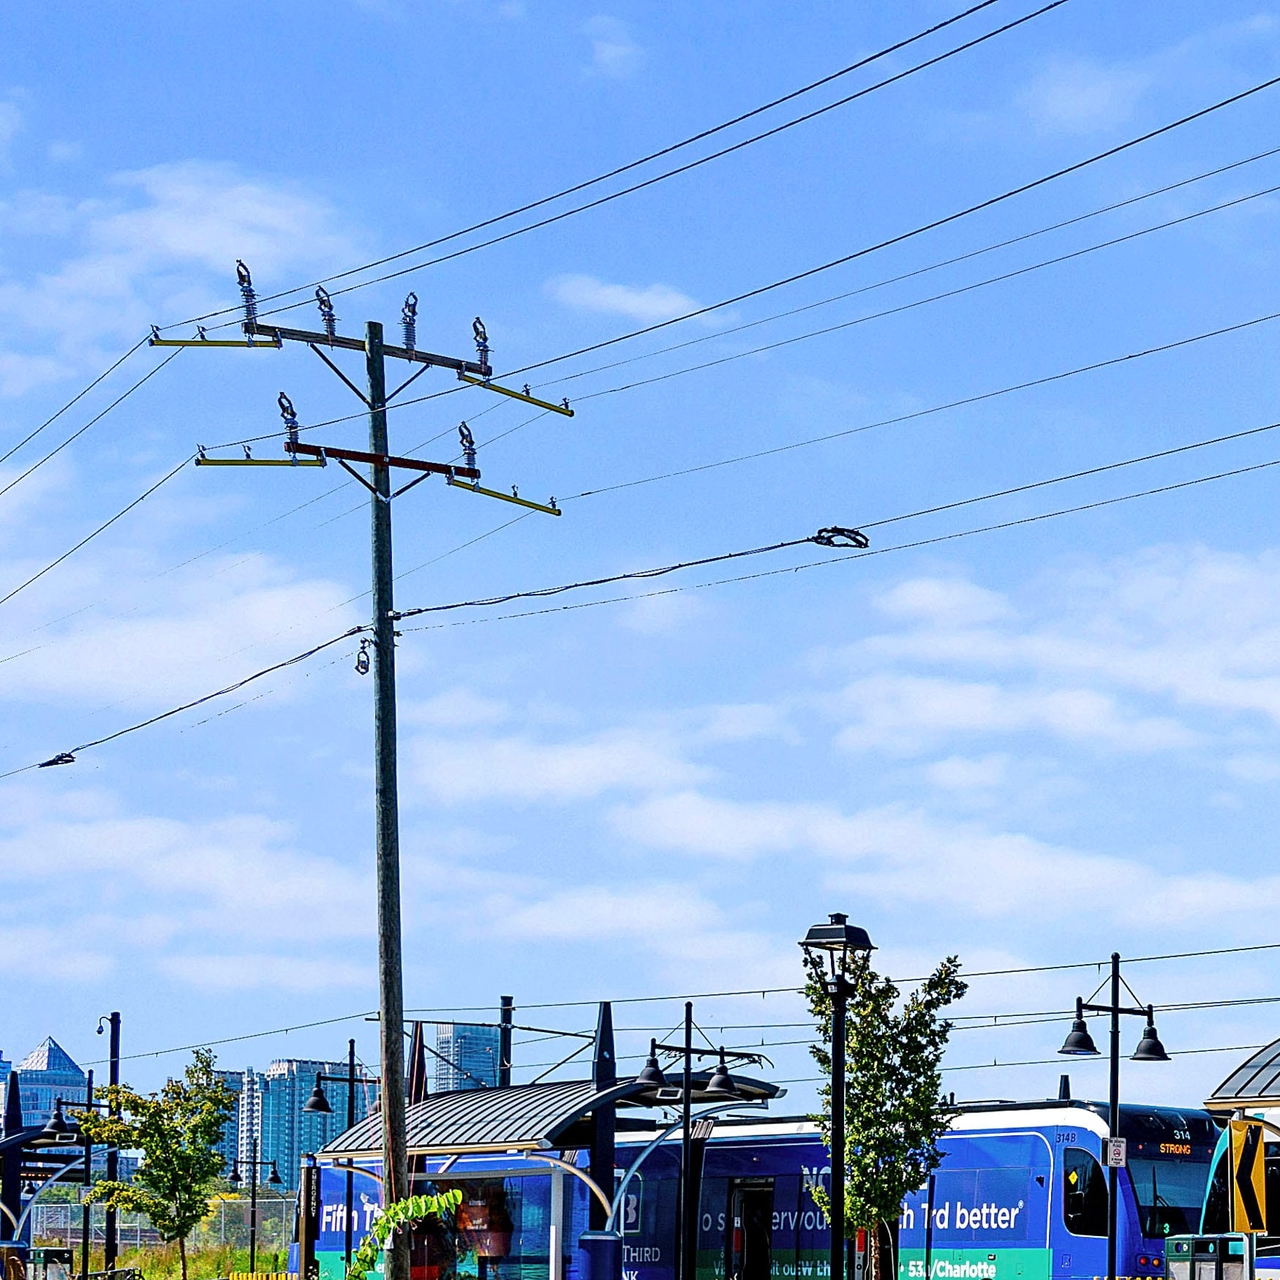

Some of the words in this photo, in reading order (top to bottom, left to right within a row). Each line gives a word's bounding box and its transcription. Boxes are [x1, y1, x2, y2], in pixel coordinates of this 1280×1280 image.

[1173, 1130, 1190, 1140] 314
[1159, 1143, 1191, 1155] STRONG
[1162, 1223, 1170, 1234] 3
[622, 1244, 661, 1262] THIRD
